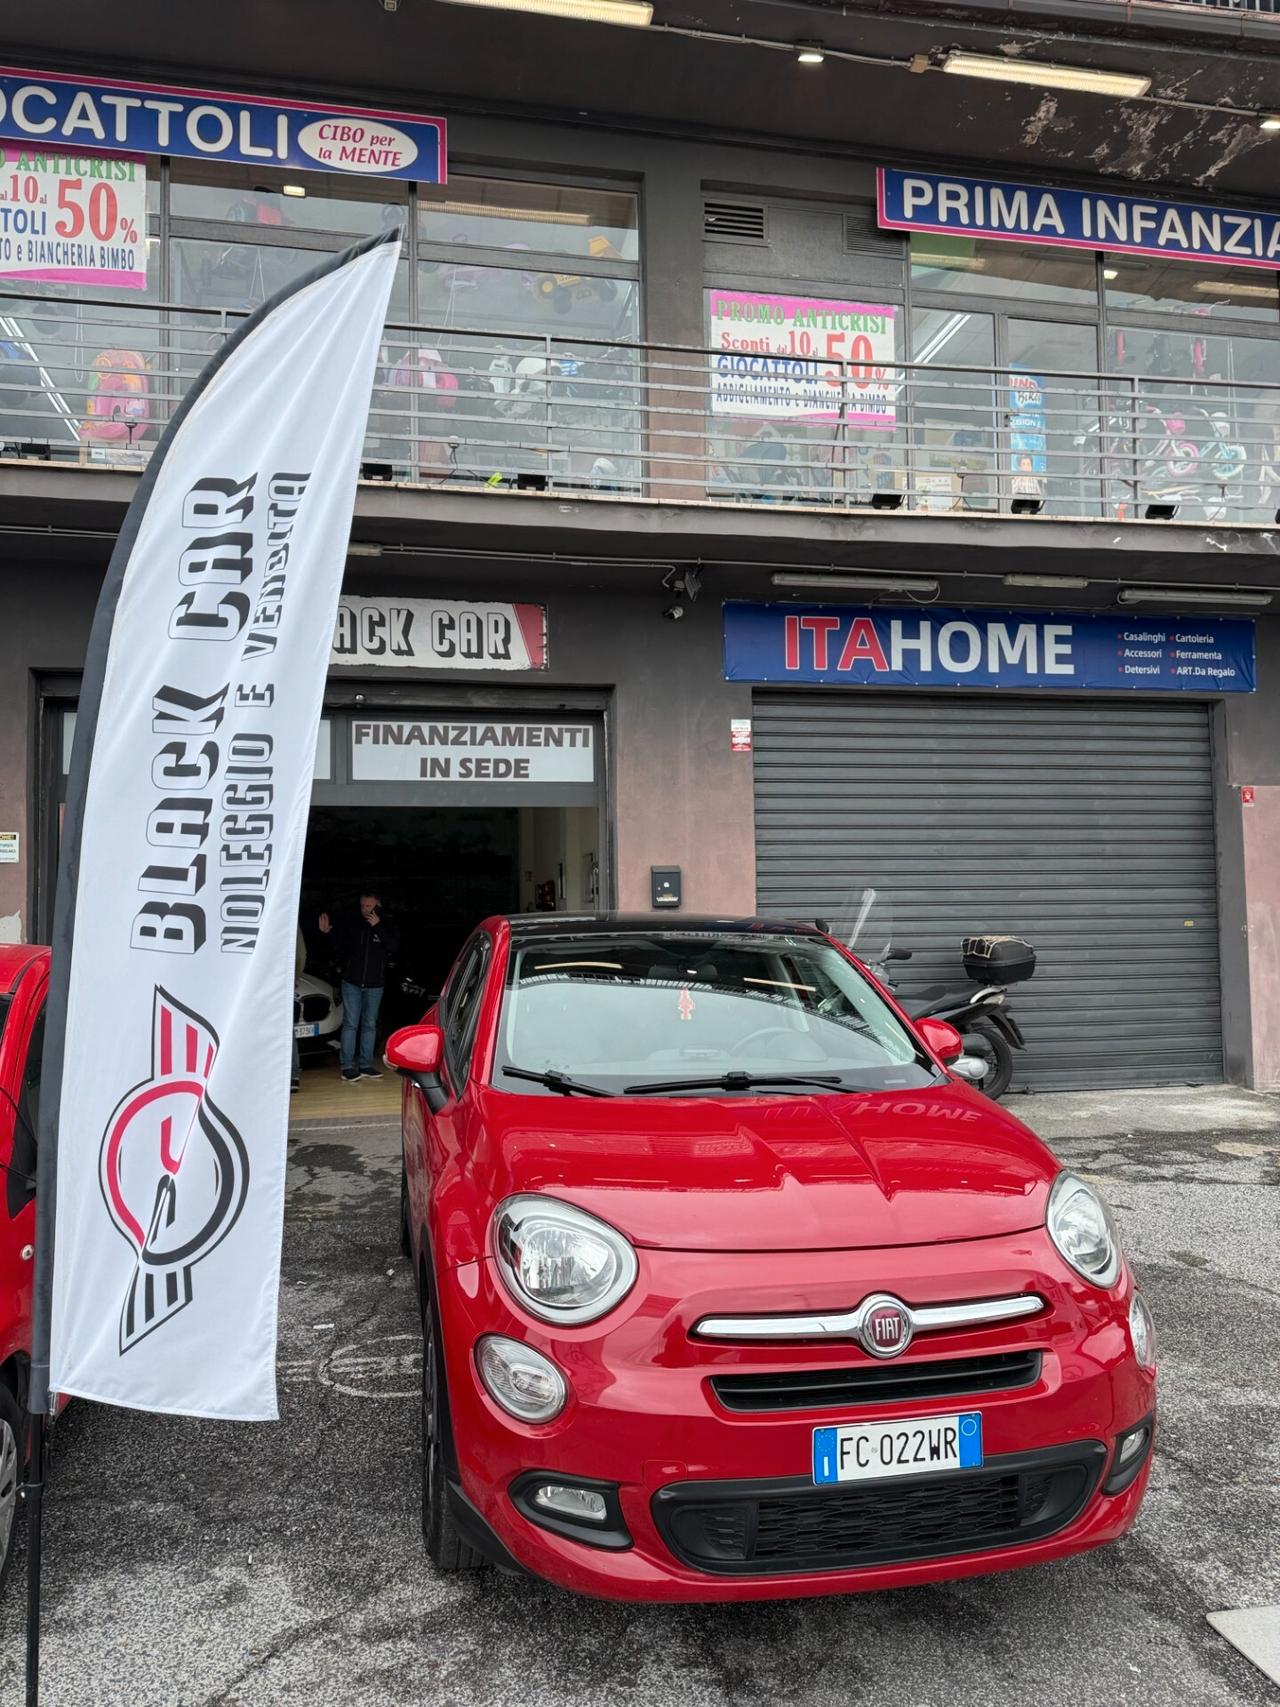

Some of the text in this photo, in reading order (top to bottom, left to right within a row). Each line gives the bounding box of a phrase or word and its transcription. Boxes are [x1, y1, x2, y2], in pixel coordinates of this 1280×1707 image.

[0, 84, 289, 160] CATTOLI
[318, 123, 396, 147] CIBO per
[16, 151, 136, 182] ANTICRISI
[318, 146, 403, 168] la MENTE
[10, 174, 39, 204] 10
[903, 178, 1065, 234] PRIMA
[17, 244, 23, 262] e
[28, 239, 96, 267] BIANCHERIA
[100, 246, 135, 271] BIMBO
[716, 299, 887, 334] PROMO ANTICRISI
[721, 331, 770, 353] Sconti
[788, 330, 811, 356] 10
[717, 354, 819, 385] GIOCATTOLI
[431, 610, 512, 660] CAR
[785, 615, 1075, 675] ITAHOME
[1124, 632, 1214, 644] Casalinghi Cartoleria
[1124, 649, 1222, 660] Accessori Ferramenta
[1125, 665, 1160, 674] Detersivi
[1208, 667, 1235, 678] Regalo
[130, 472, 259, 955] BLACK CAR
[220, 472, 312, 954] NOLEGGIO E VENDITA
[354, 724, 590, 748] FINANZIAMENTI
[419, 758, 530, 779] IN SEDE
[875, 1317, 899, 1340] FIAT
